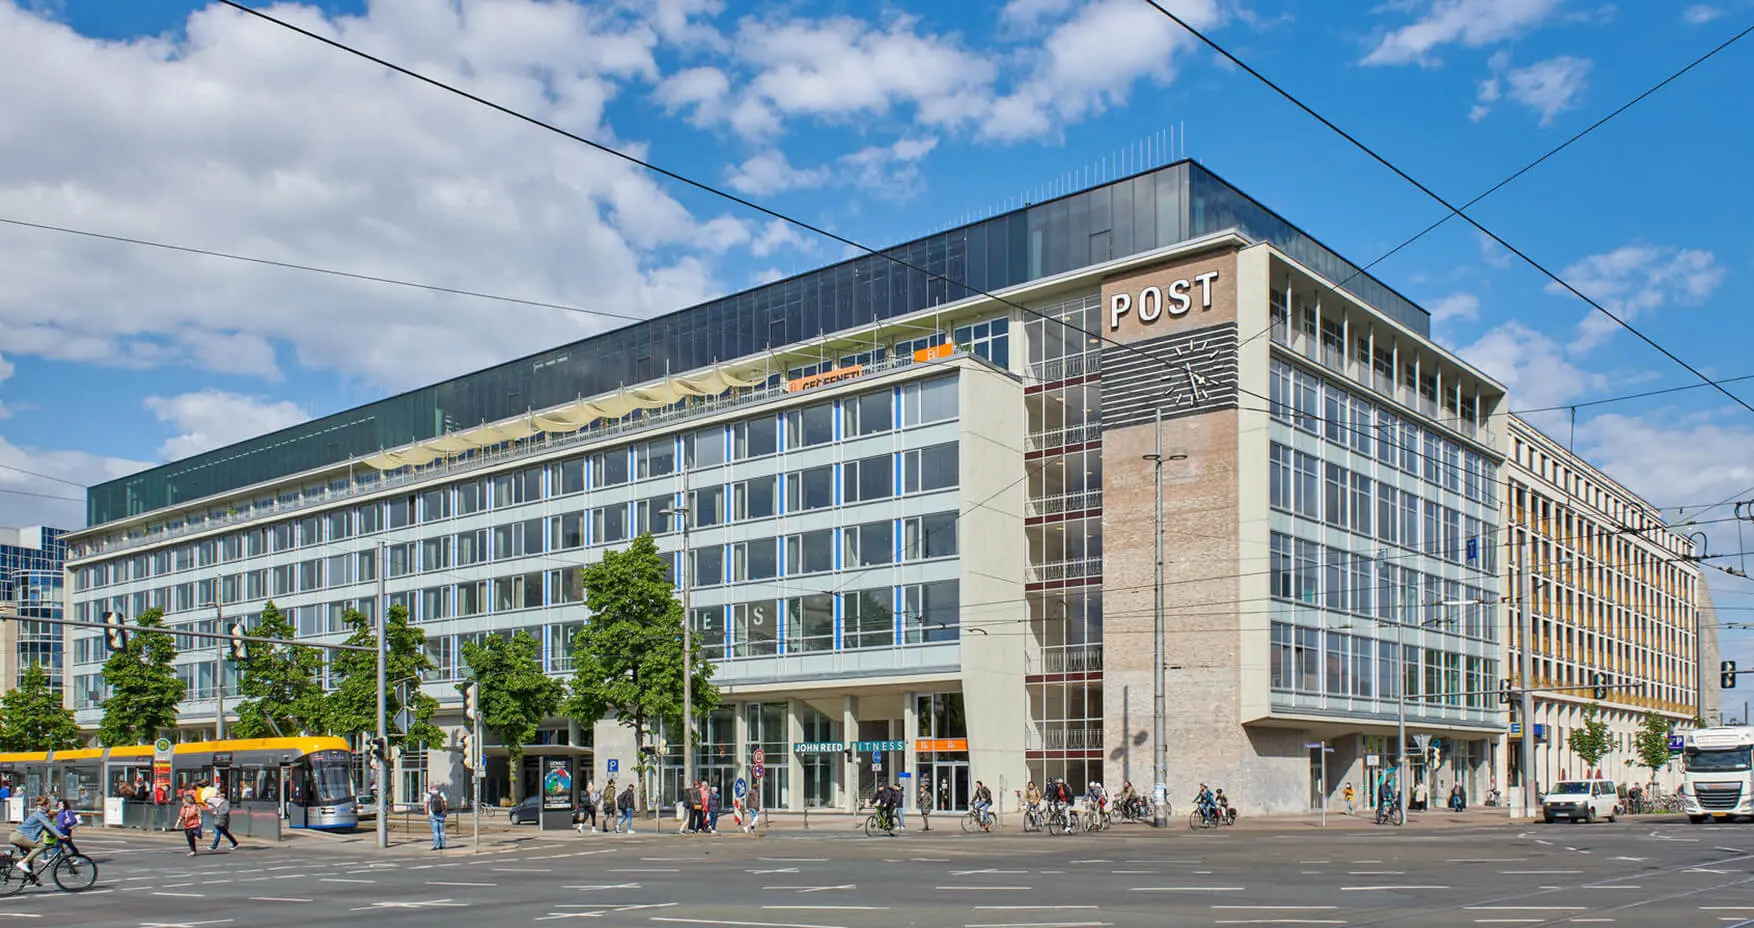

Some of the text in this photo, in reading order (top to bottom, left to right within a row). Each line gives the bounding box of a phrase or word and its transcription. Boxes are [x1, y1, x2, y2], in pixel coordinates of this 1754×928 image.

[1110, 270, 1219, 330] POST
[703, 612, 712, 630] E
[753, 607, 764, 626] S
[795, 741, 904, 752] JOHN REED ITNESS
[609, 760, 617, 772] P
